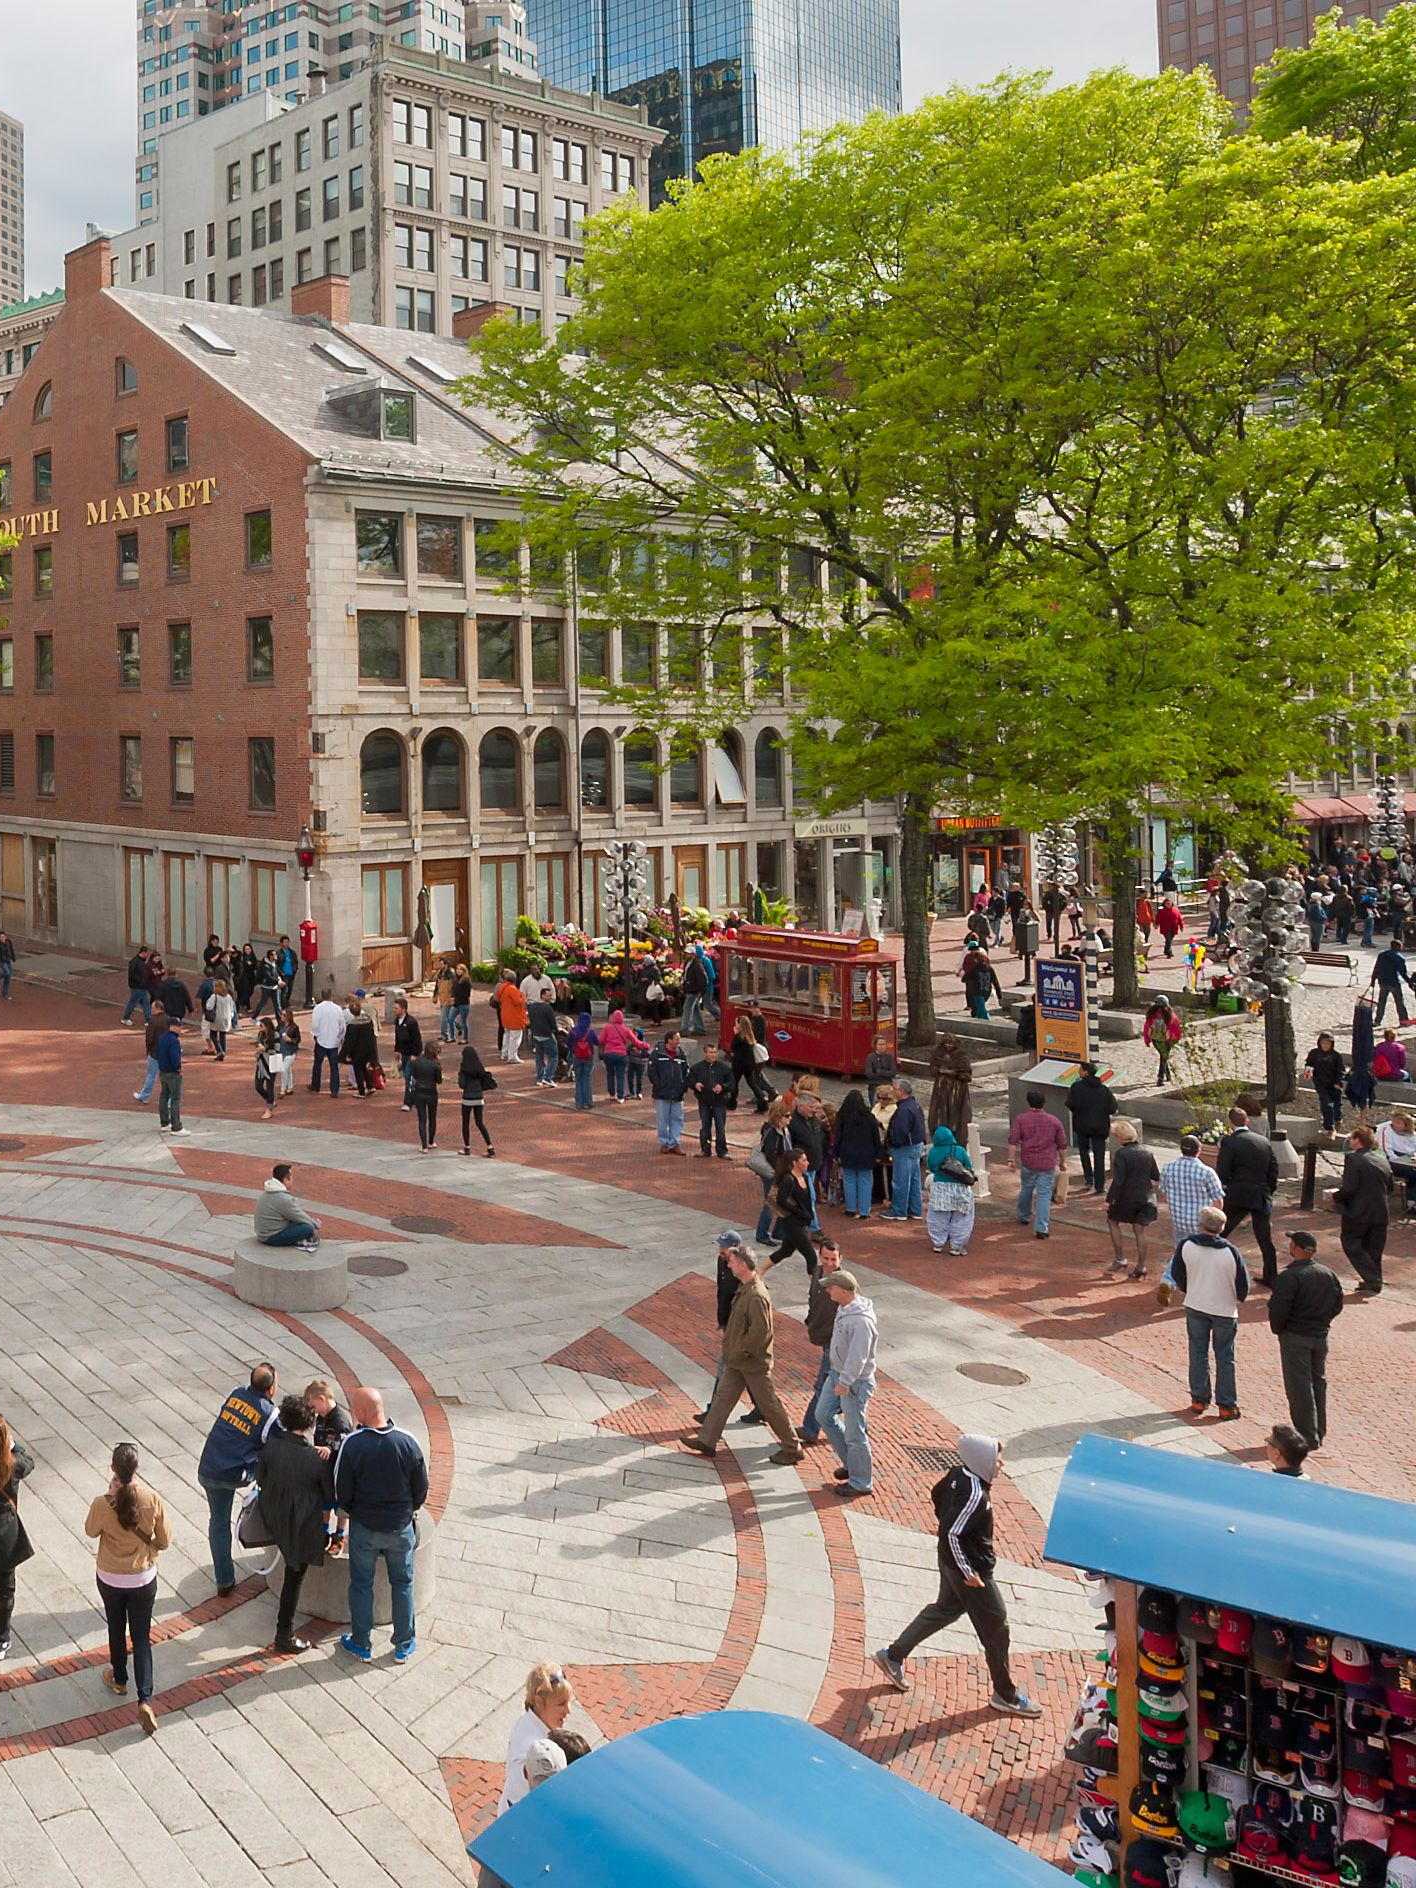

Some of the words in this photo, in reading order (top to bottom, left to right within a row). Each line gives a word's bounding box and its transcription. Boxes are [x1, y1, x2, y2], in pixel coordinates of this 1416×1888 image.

[86, 477, 216, 527] MARKET
[811, 823, 852, 835] ORIGINS
[1041, 964, 1068, 973] Welcome
[788, 1022, 822, 1040] TROLLEY
[1272, 1628, 1285, 1646] B
[1344, 1649, 1353, 1662] B
[1148, 1755, 1177, 1770] Boston
[1138, 1804, 1168, 1824] Boston
[1312, 1804, 1325, 1823] B
[1189, 1824, 1219, 1841] Boston
